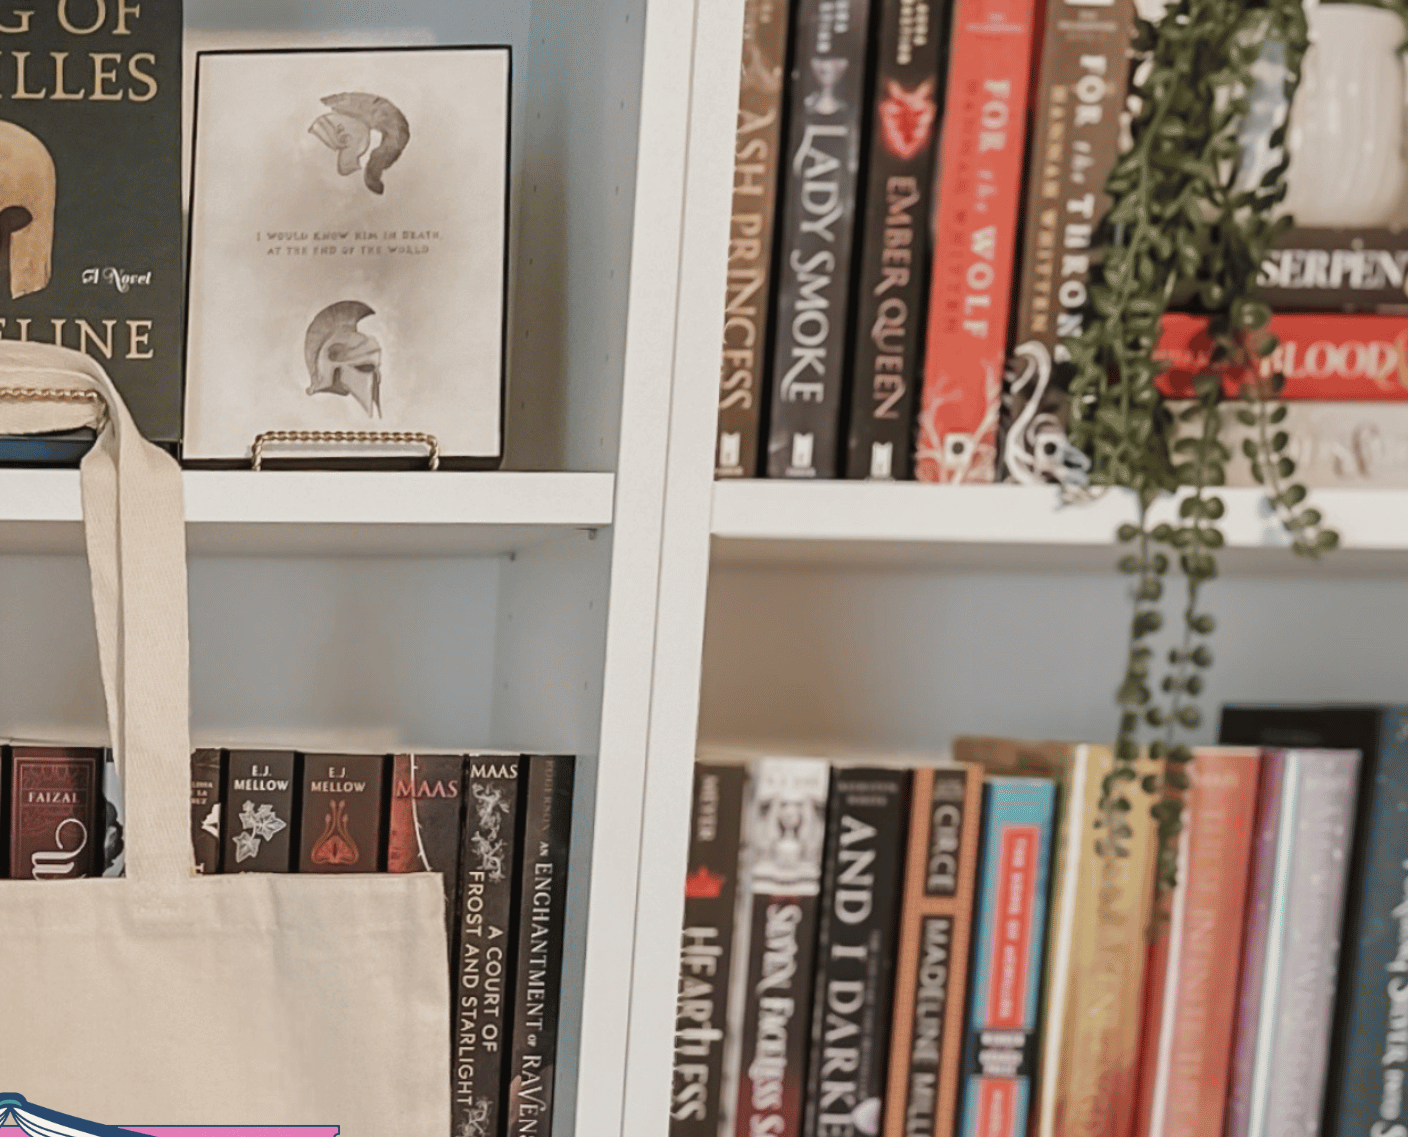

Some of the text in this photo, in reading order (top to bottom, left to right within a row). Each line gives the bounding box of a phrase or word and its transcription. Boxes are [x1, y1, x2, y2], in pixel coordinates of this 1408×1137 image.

[977, 78, 1012, 153] FOR
[1074, 54, 1108, 128] FOR
[267, 231, 309, 241] WOULD
[718, 106, 778, 412] ASH PRINCESS
[780, 123, 849, 404] LADY SMOKE
[103, 267, 152, 292] Novel
[870, 175, 920, 421] EMBER QUEEN
[961, 224, 998, 338] WOLF
[233, 779, 289, 791] MELLOW
[310, 780, 367, 794] MELLOW
[396, 779, 459, 798] MAAS
[470, 763, 519, 779] MAAS
[833, 814, 878, 925] AND
[926, 803, 962, 892] CIRCE
[526, 862, 553, 1031] ENCHANTMENT
[831, 944, 869, 961] I
[456, 871, 485, 1106] FROST AND STARLIGHT
[481, 925, 504, 1053] A COURT OF
